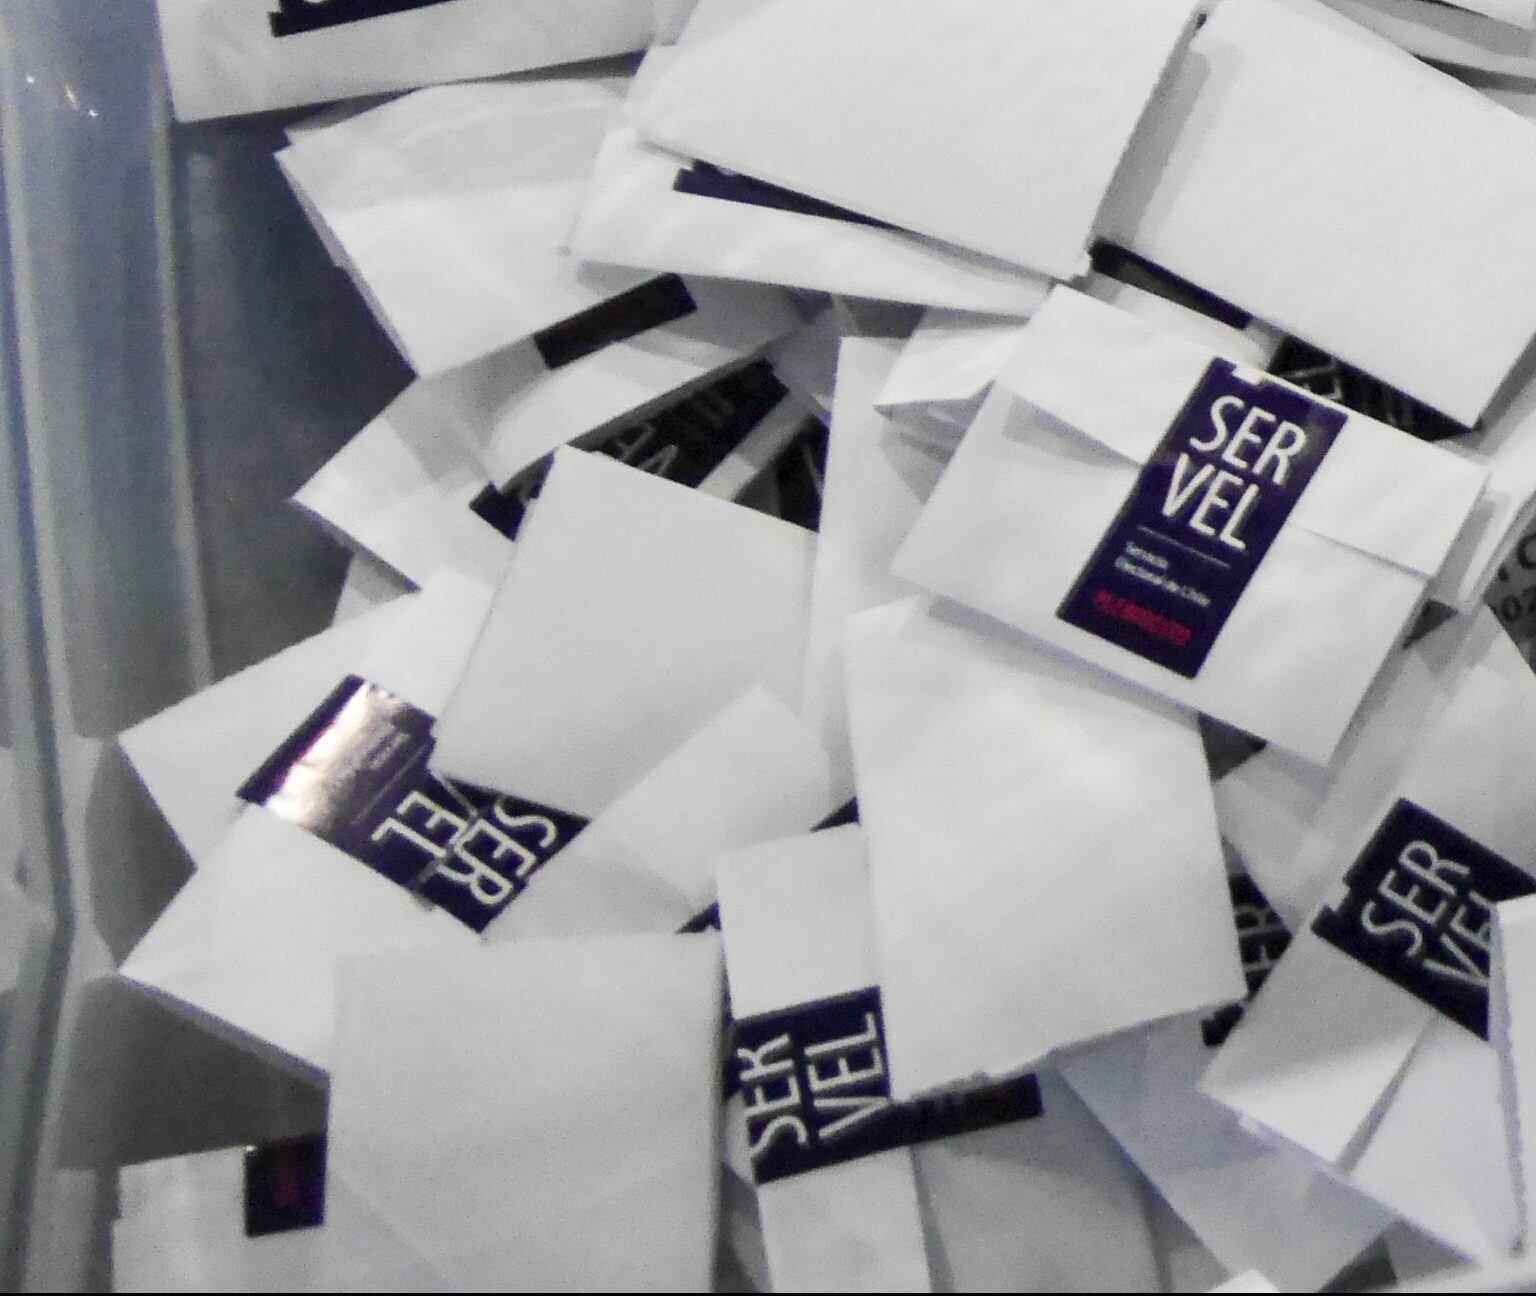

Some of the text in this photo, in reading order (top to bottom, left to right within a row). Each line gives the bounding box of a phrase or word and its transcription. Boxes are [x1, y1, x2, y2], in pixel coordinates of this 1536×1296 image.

[1189, 395, 1310, 486] SER
[1161, 452, 1260, 551] VEL
[433, 803, 559, 907] SER
[1360, 840, 1470, 957] SER
[736, 1033, 808, 1155] SER
[803, 1012, 889, 1139] VEL
